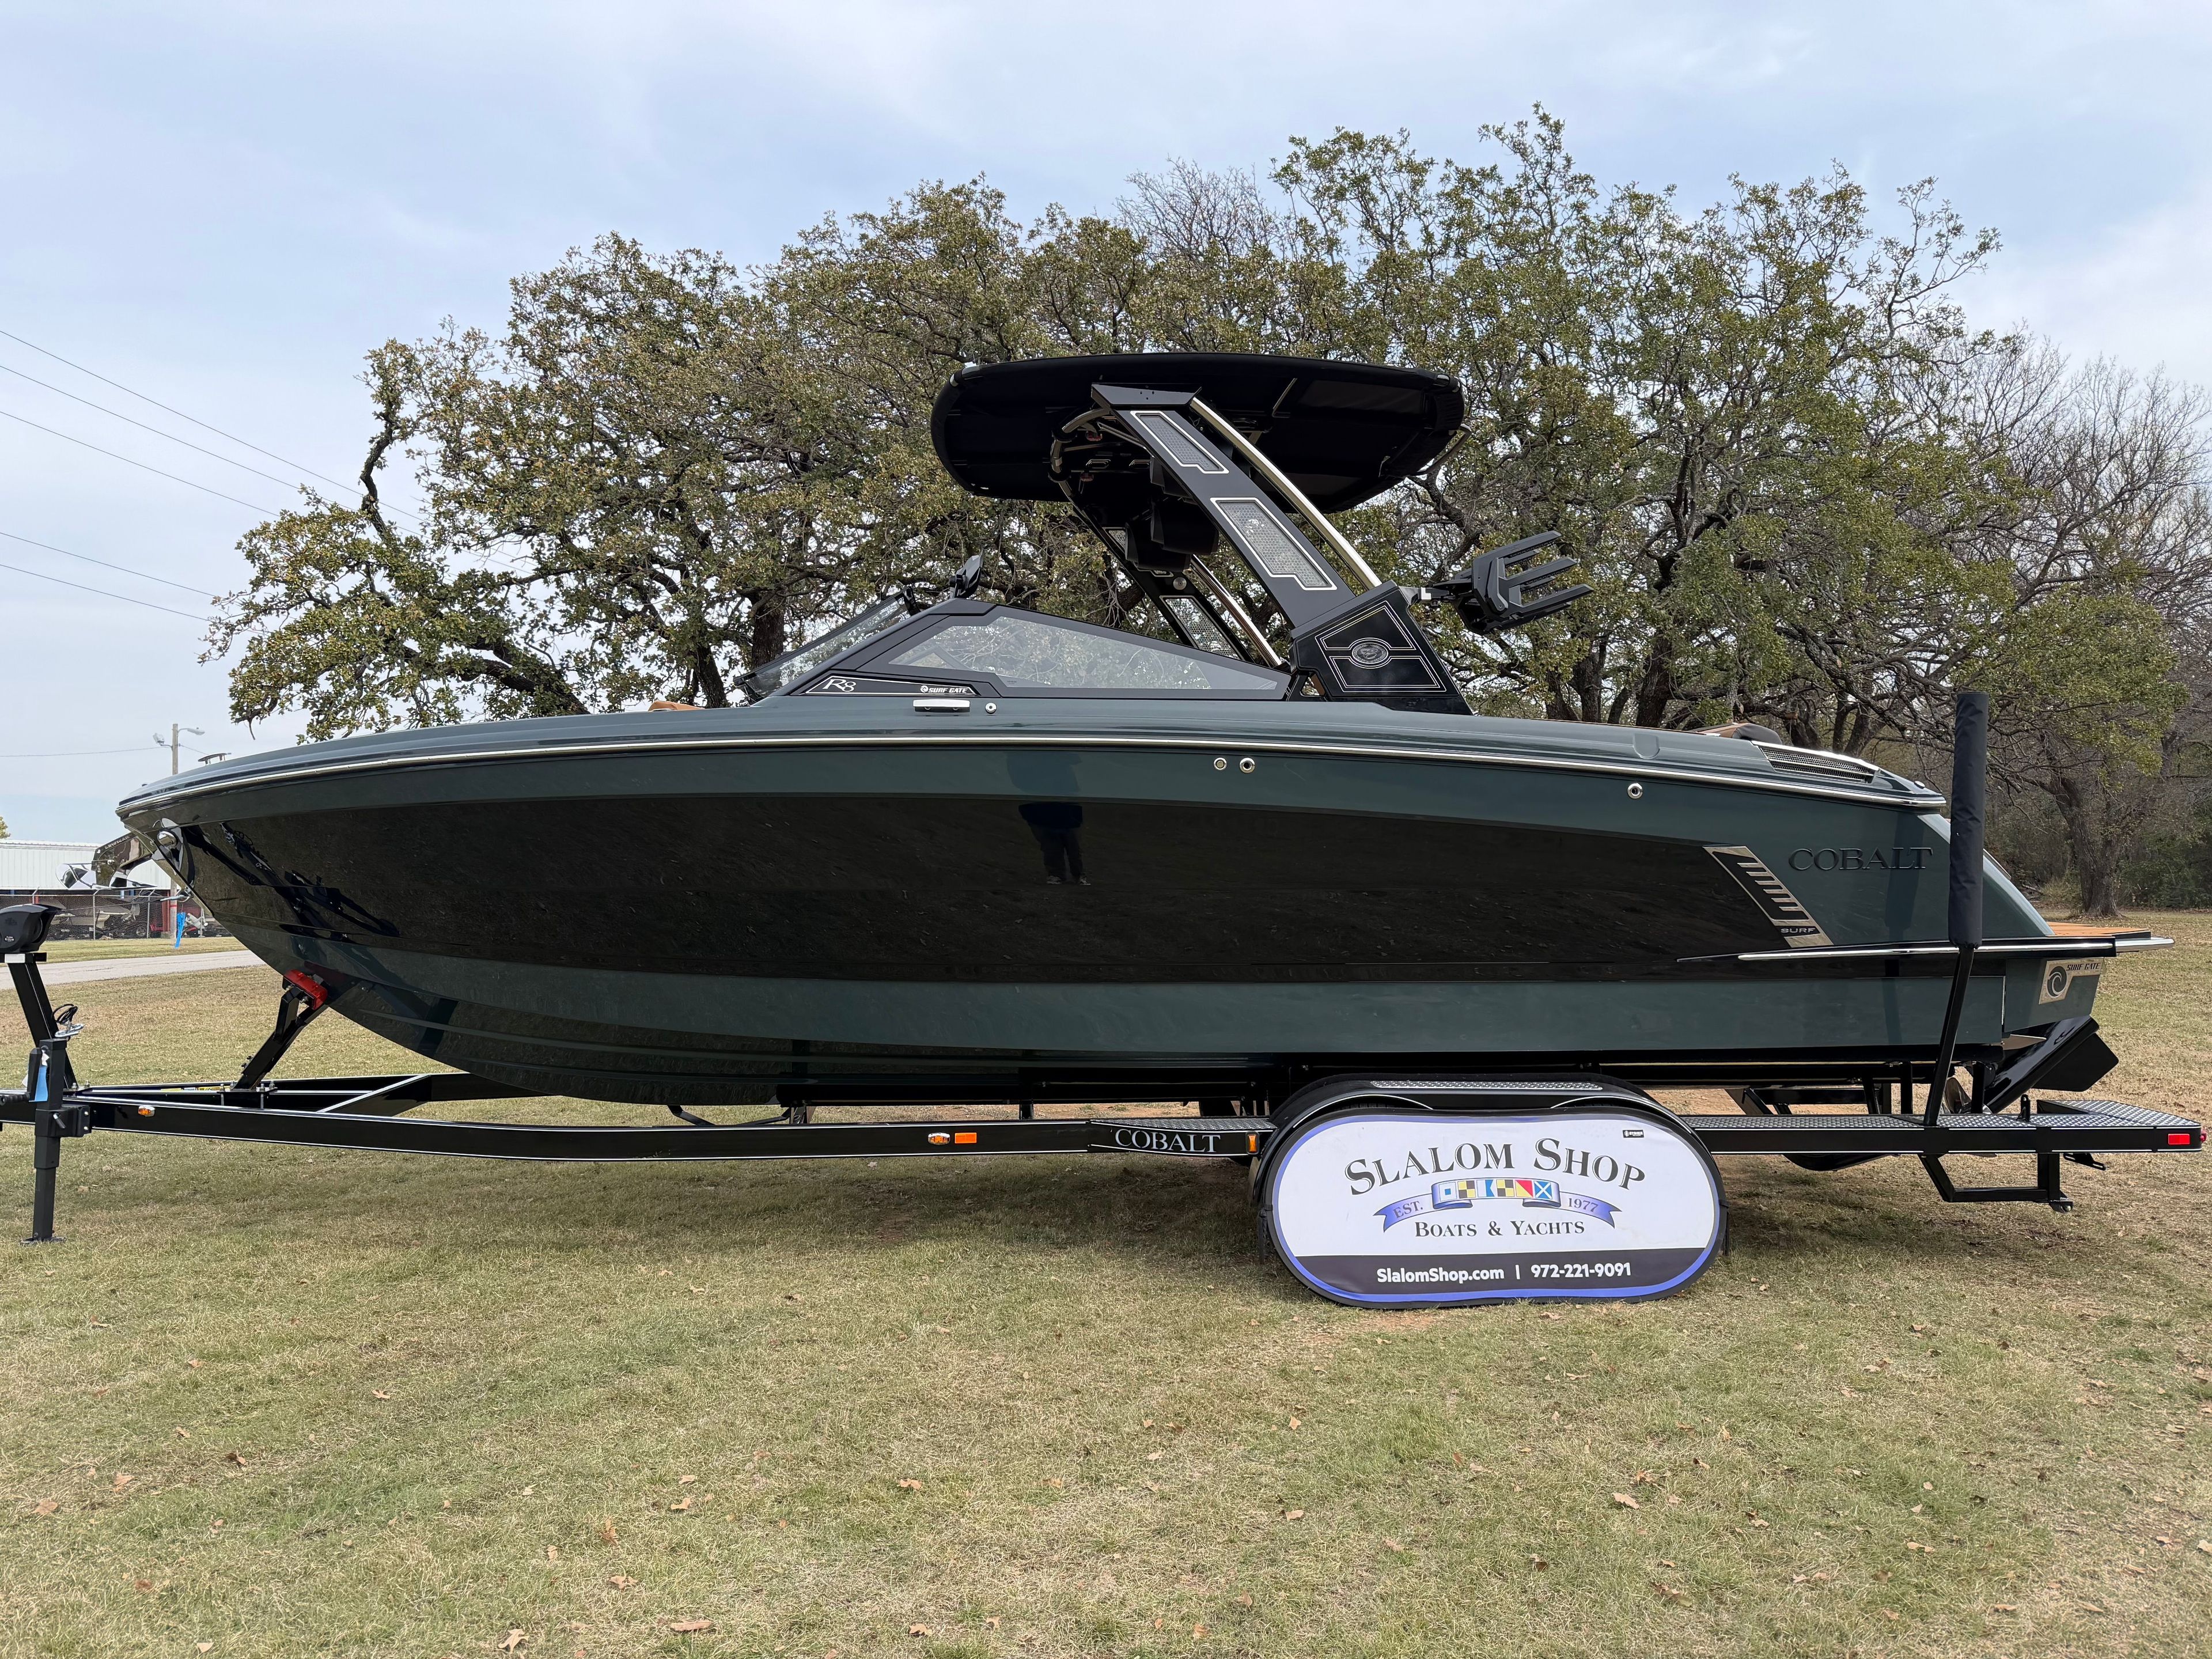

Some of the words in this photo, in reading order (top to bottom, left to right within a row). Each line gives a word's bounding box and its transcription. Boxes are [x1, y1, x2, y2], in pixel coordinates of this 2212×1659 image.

[822, 679, 857, 692] R8
[1789, 847, 1933, 871] COBALT
[1115, 1128, 1221, 1153] COBALT
[1344, 1143, 1516, 1195] SLALOM
[1533, 1138, 1646, 1191] SHOP
[1393, 1200, 1423, 1219] EST.
[1567, 1198, 1599, 1213] 1977
[1415, 1221, 1478, 1237] BOATS
[1488, 1221, 1503, 1236] &
[1510, 1221, 1585, 1236] YACHTS
[1377, 1267, 1505, 1284] SlalomShop.com
[1531, 1262, 1631, 1278] 972-221-9091
